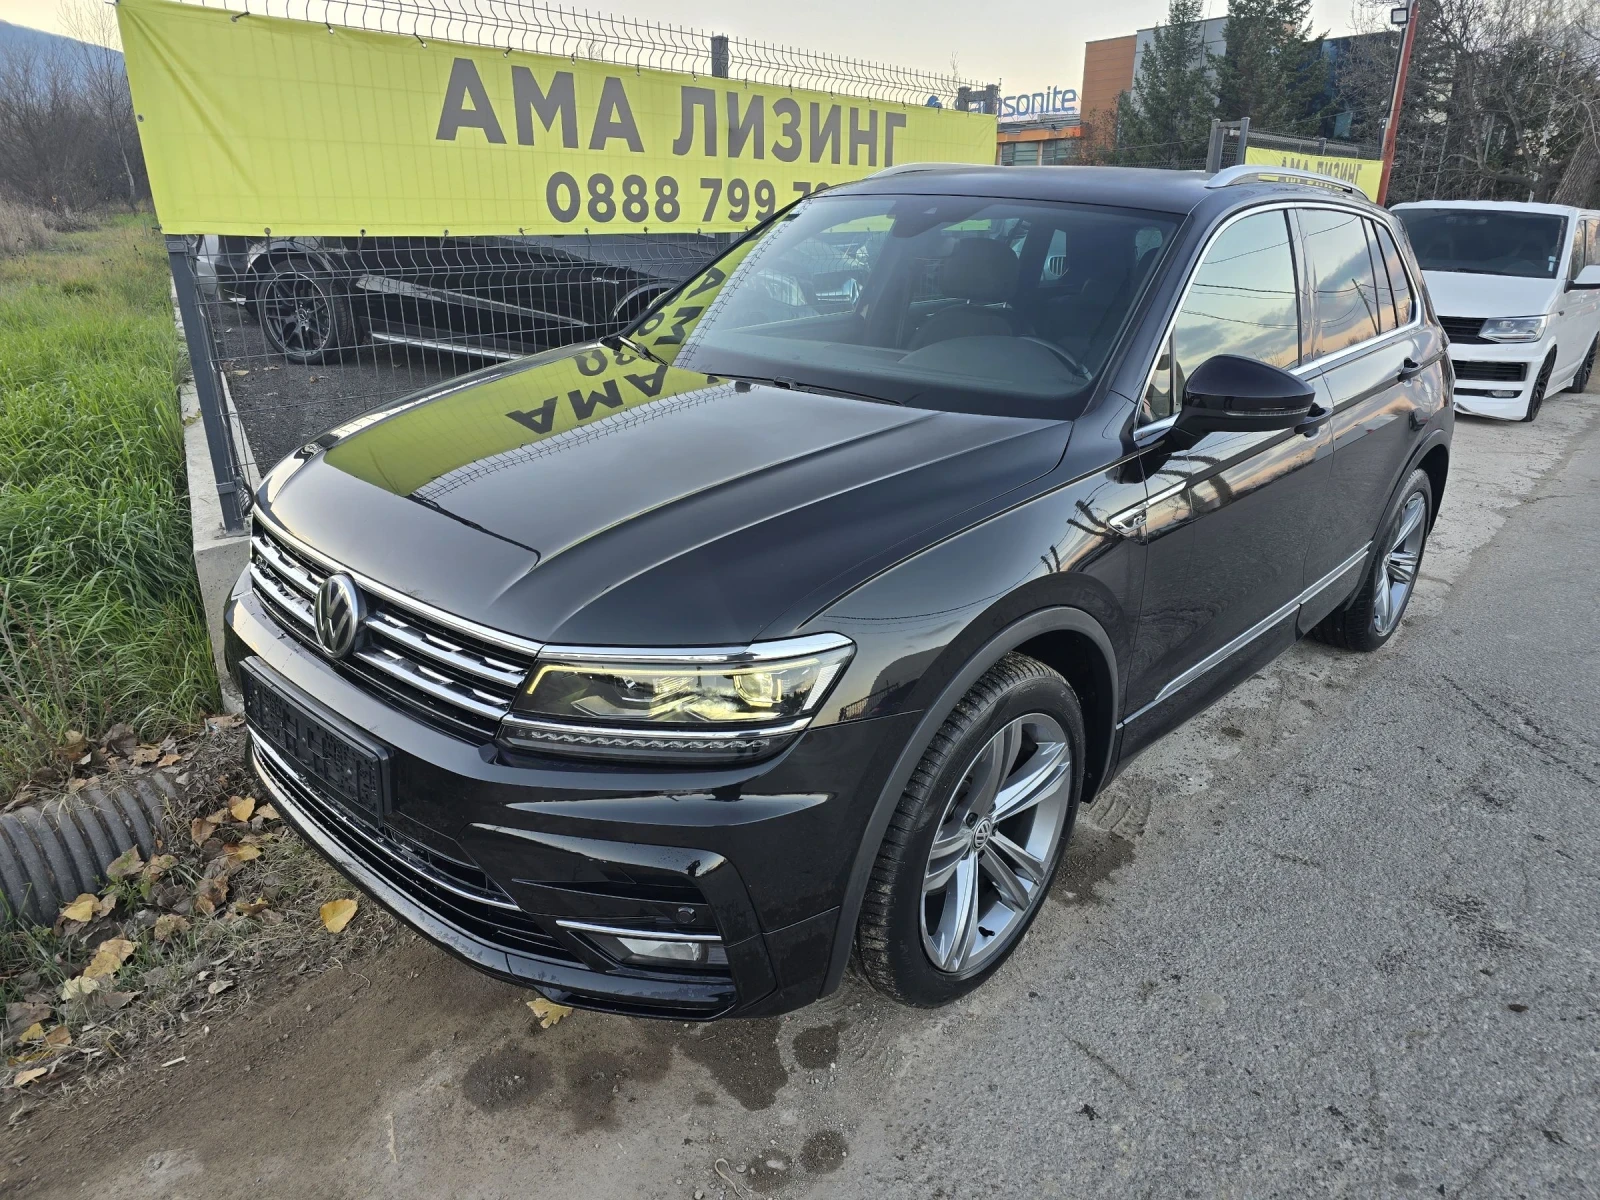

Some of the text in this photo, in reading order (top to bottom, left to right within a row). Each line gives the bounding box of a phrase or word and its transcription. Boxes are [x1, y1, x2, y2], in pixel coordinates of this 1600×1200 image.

[435, 56, 907, 168] АМА ЛИЗИНГ
[546, 171, 776, 223] 0888 799
